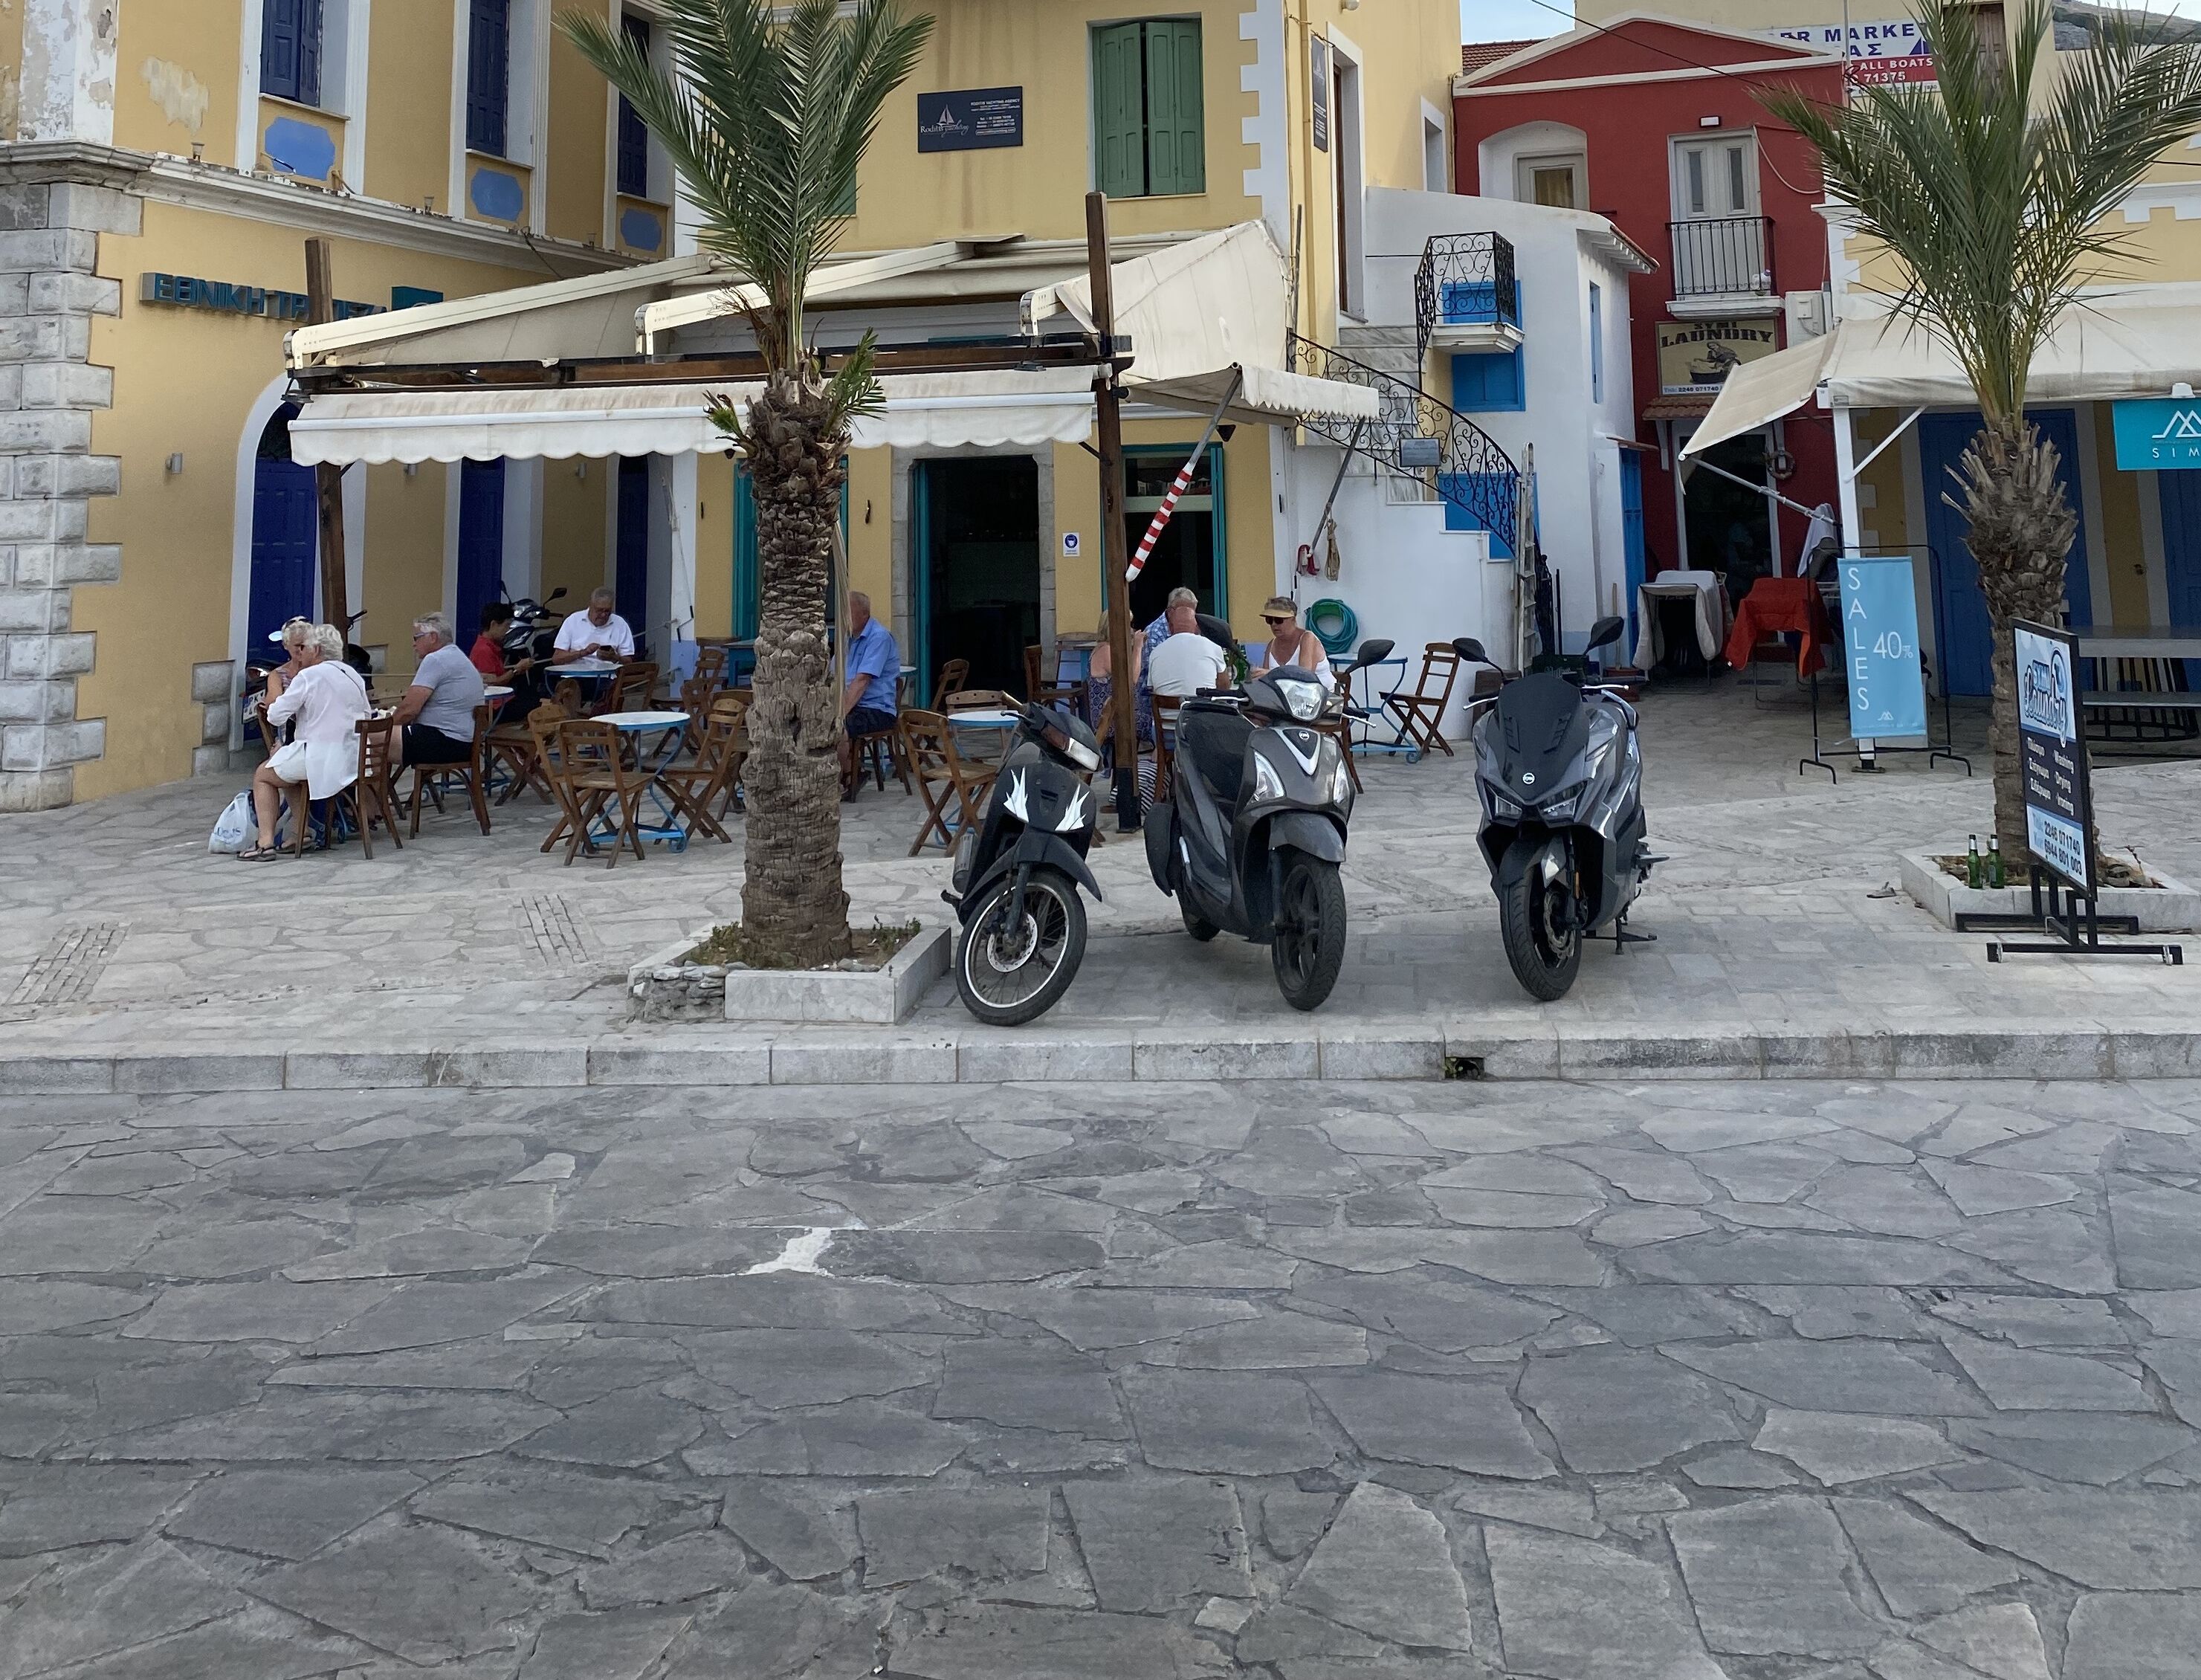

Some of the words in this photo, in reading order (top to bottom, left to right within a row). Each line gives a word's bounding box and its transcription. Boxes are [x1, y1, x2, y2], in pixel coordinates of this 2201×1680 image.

[1824, 23, 1916, 43] MARKE
[1860, 61, 1885, 71] ALL
[1889, 57, 1933, 70] BOATS
[1864, 70, 1907, 83] 71375
[153, 272, 266, 315] ΕΘΝΙΚΗ
[1661, 328, 1774, 348] LAUNDRY
[1848, 567, 1870, 711] SALES
[1872, 631, 1914, 659] 40%
[2023, 664, 2068, 749] Laundry
[2054, 749, 2074, 775] Washing
[2055, 771, 2072, 794] Drying
[2058, 829, 2081, 856] 071740
[2044, 839, 2058, 859] 6944
[2070, 856, 2082, 876] 003
